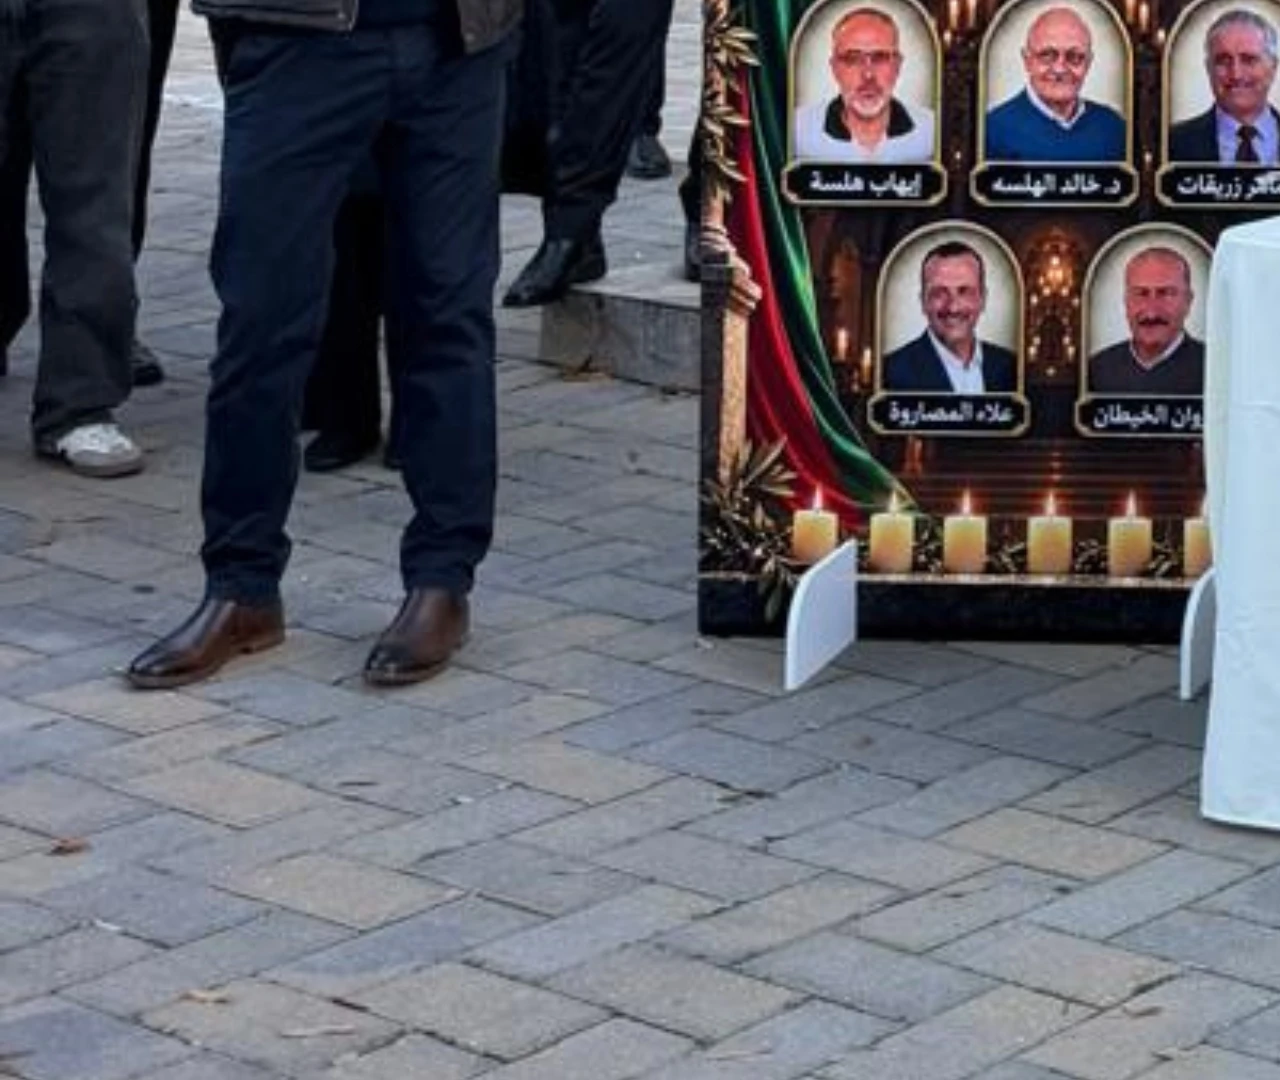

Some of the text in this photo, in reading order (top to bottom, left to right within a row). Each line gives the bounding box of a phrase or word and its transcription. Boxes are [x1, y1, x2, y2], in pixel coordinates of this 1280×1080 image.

[809, 170, 922, 198] إيهاب هلسة
[1059, 173, 1100, 195] خالد
[1177, 172, 1243, 201] زريقات
[888, 401, 1014, 427] علاء المصاروة
[1093, 403, 1169, 428] الخيطان
